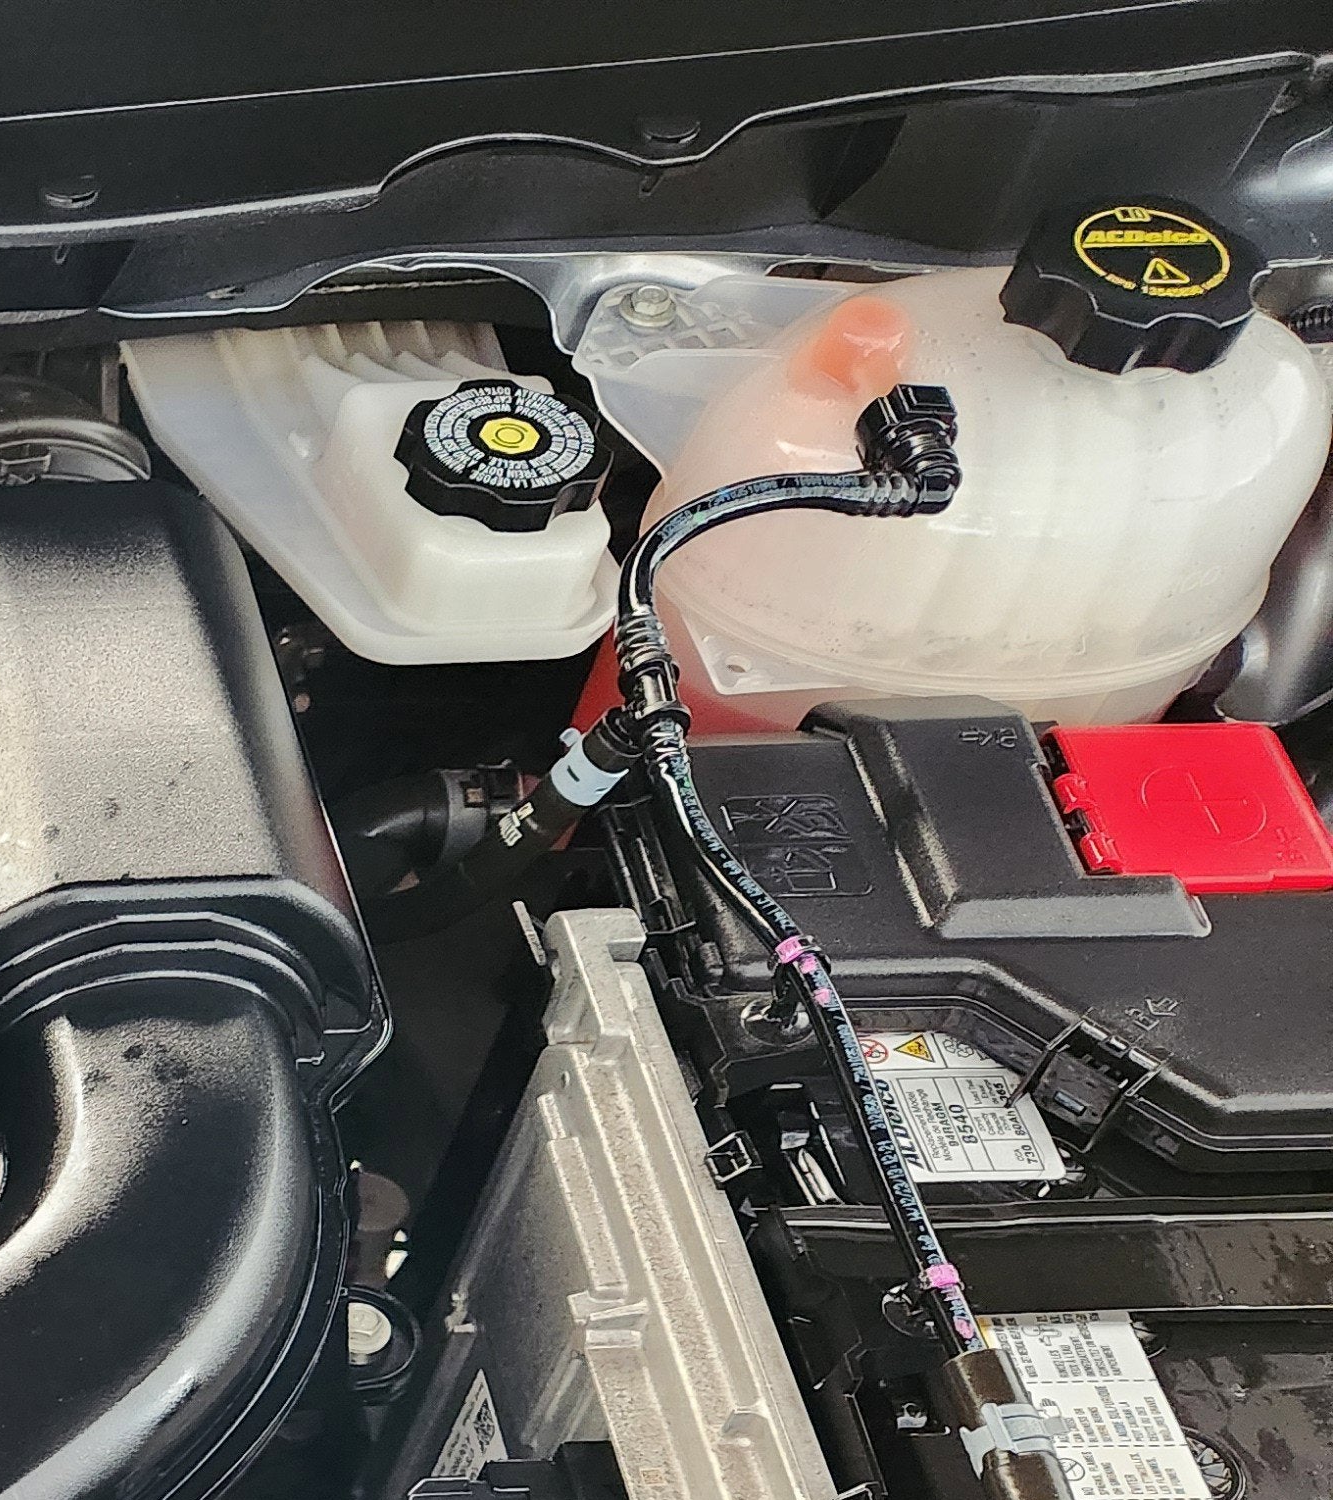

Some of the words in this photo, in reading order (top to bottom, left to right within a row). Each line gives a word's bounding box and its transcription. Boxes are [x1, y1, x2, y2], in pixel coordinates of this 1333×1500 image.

[1084, 230, 1209, 243] ACDelco
[905, 1092, 922, 1113] Model
[915, 1089, 939, 1124] Rechange
[930, 1126, 942, 1135] de
[931, 1103, 959, 1147] 94RAGM
[947, 1105, 978, 1144] 8540
[1005, 1111, 1026, 1136] 80Ah
[913, 1114, 942, 1159] Replacement
[1021, 1145, 1039, 1165] 730
[1143, 1397, 1161, 1415] GRAVES
[1081, 1487, 1095, 1496] NO
[1144, 1486, 1158, 1495] LES
[1158, 1485, 1172, 1495] LES
